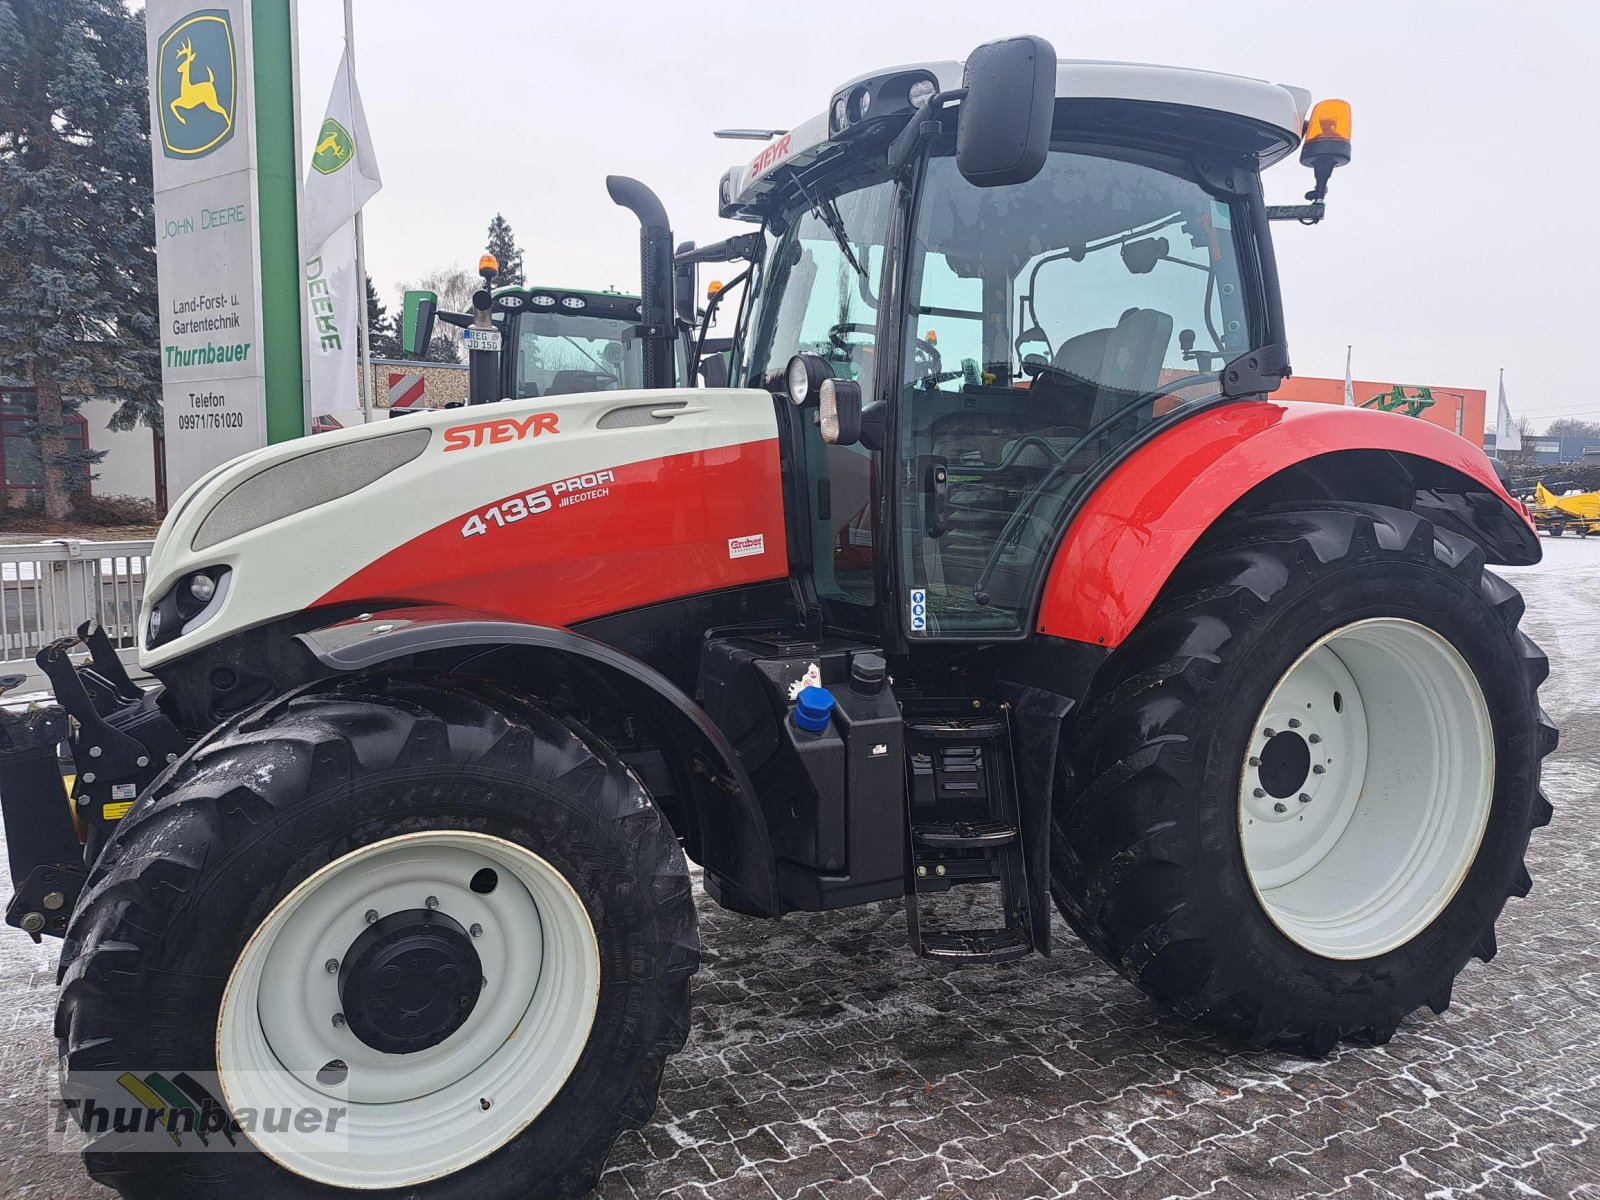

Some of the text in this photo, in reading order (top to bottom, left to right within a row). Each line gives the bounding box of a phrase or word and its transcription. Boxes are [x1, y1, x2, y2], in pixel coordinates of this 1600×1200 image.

[751, 134, 791, 178] STEYR
[162, 205, 245, 240] JOHN DEERE
[173, 294, 240, 315] Land-Forst- u.
[306, 256, 342, 352] DEERE
[172, 313, 240, 335] Gartentechnik
[470, 332, 487, 341] REG
[481, 341, 498, 349] 150
[165, 342, 251, 369] Thurnbauer
[189, 392, 225, 409] Telefon
[178, 412, 243, 430] 09971/761020
[443, 411, 560, 452] STEYR
[551, 469, 615, 497] PROFI
[569, 487, 610, 506] ECOTECH
[460, 490, 552, 539] 4135
[731, 538, 762, 550] Gruber
